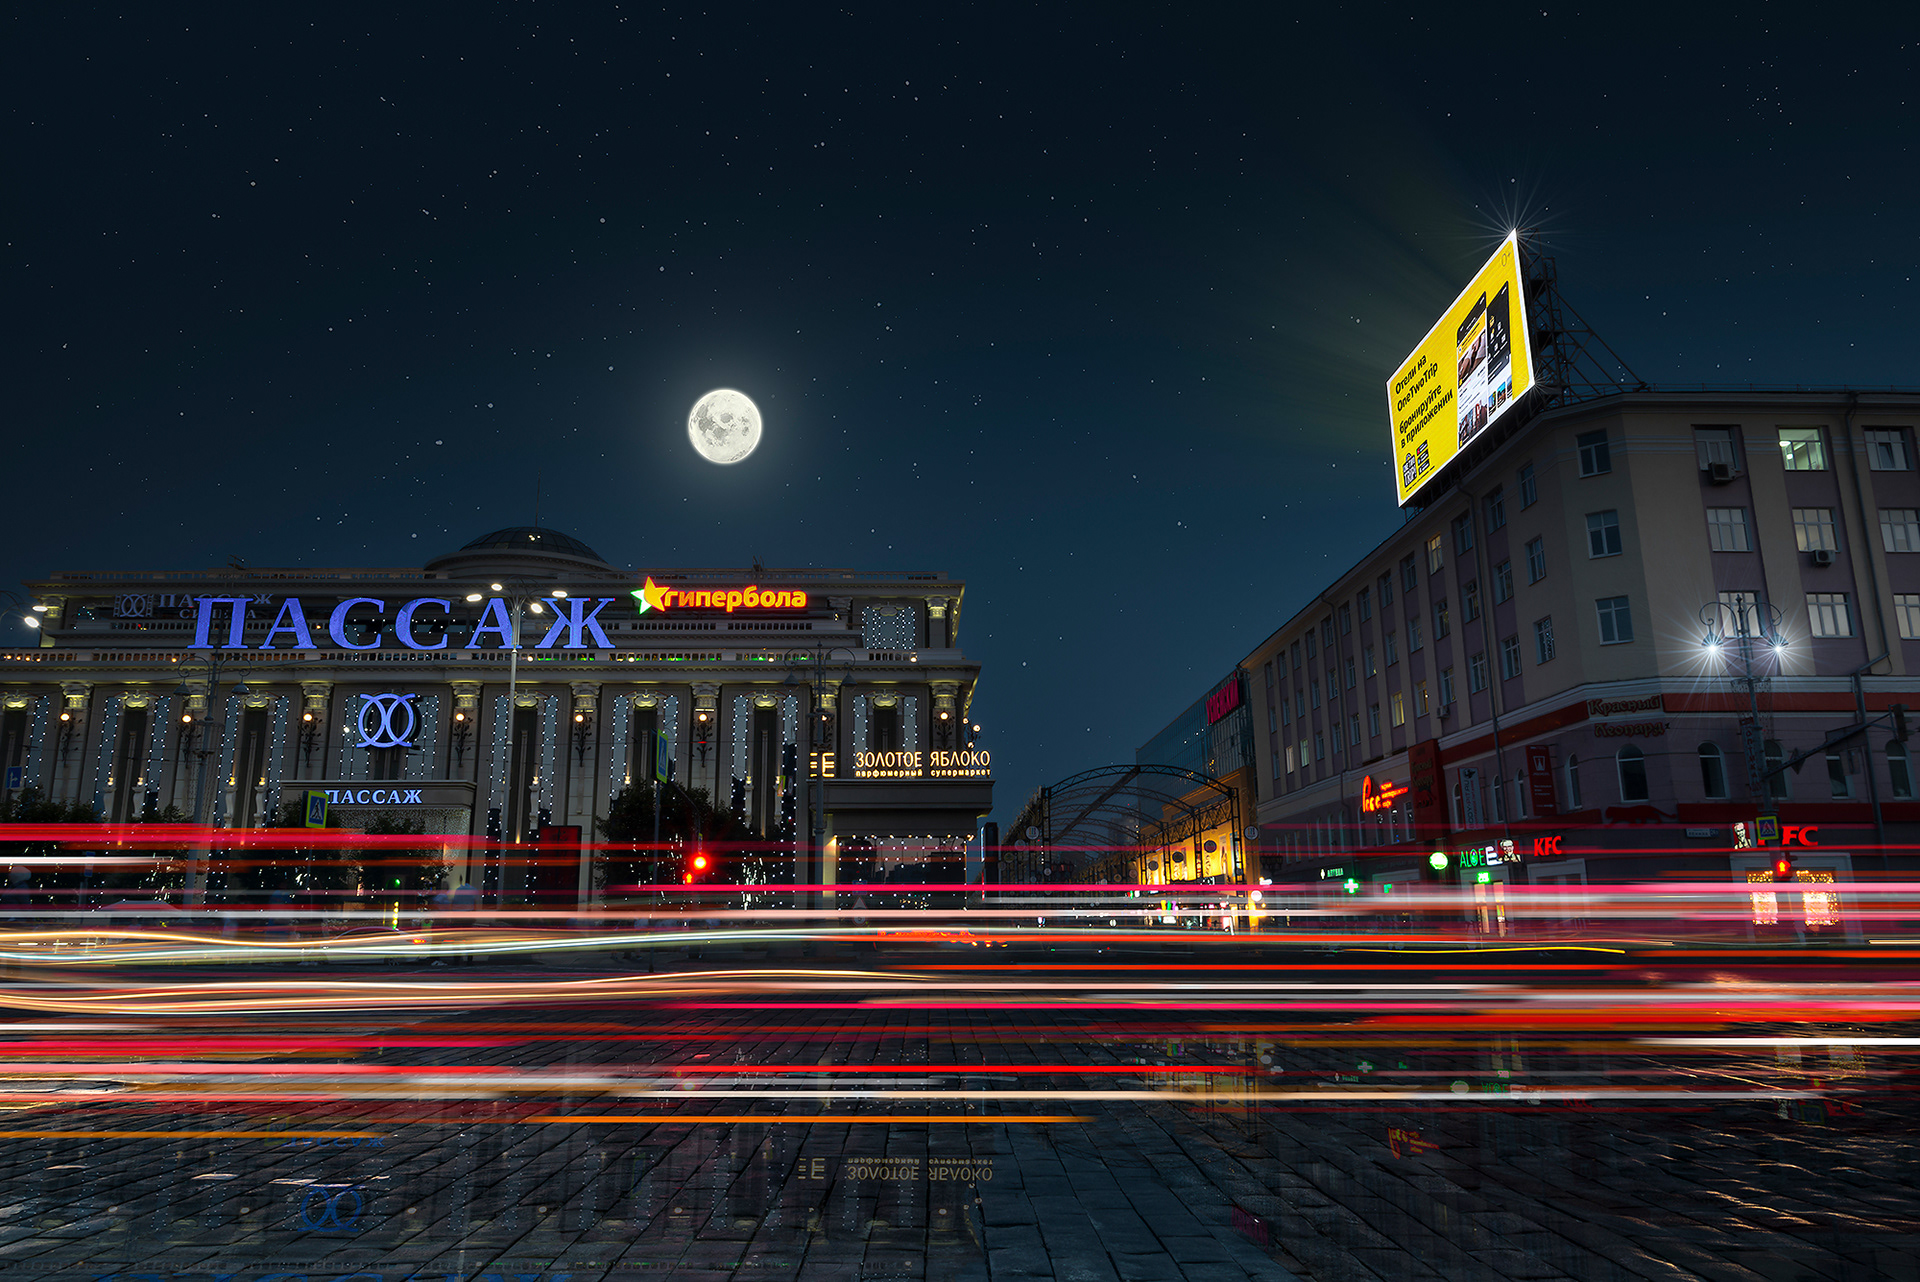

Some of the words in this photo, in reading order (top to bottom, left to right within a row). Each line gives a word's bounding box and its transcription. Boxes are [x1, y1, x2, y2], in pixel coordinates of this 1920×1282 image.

[1395, 366, 1417, 395] Отели
[1416, 354, 1427, 373] на
[1397, 362, 1438, 412] OneTwoTrip
[1399, 384, 1442, 435] бронируйте
[1401, 437, 1406, 449] в
[1406, 388, 1453, 442] приложении
[663, 585, 806, 612] гипербола
[187, 597, 615, 649] ПАССАЖ
[1588, 694, 1661, 717] Красный
[1594, 721, 1665, 738] Леопард
[855, 751, 923, 768] ЗОЛОТОЕ
[930, 750, 991, 767] ЯБЛОКО
[855, 768, 923, 779] парфюмерный
[930, 768, 991, 779] супермаркет
[325, 788, 424, 805] ПАССАЖ
[1533, 835, 1562, 857] KFC
[1757, 826, 1819, 847] FC
